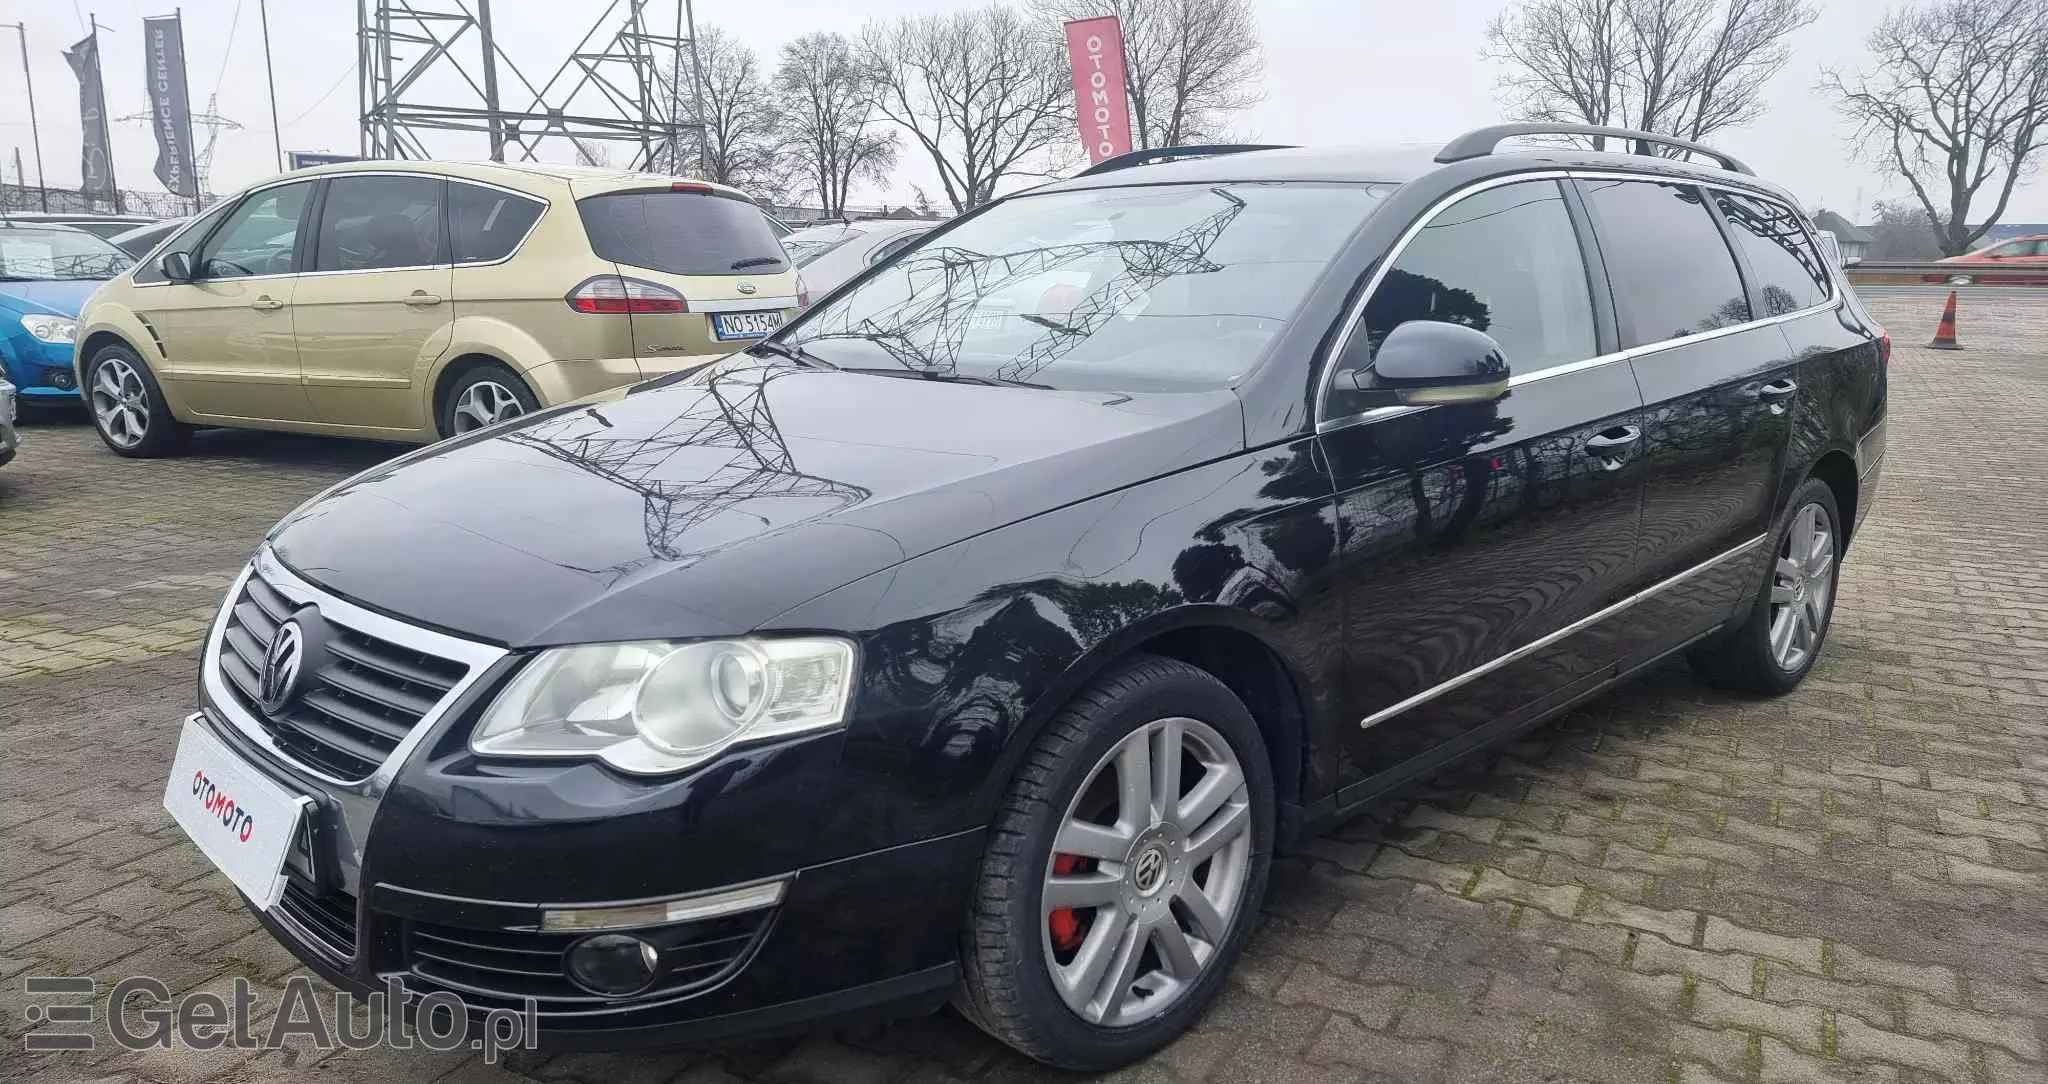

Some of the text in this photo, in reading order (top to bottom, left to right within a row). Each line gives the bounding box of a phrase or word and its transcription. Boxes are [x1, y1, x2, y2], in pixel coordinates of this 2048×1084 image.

[1086, 35, 1114, 157] OTOMOTO
[723, 316, 744, 333] NO
[192, 770, 253, 842] OTOMOTO
